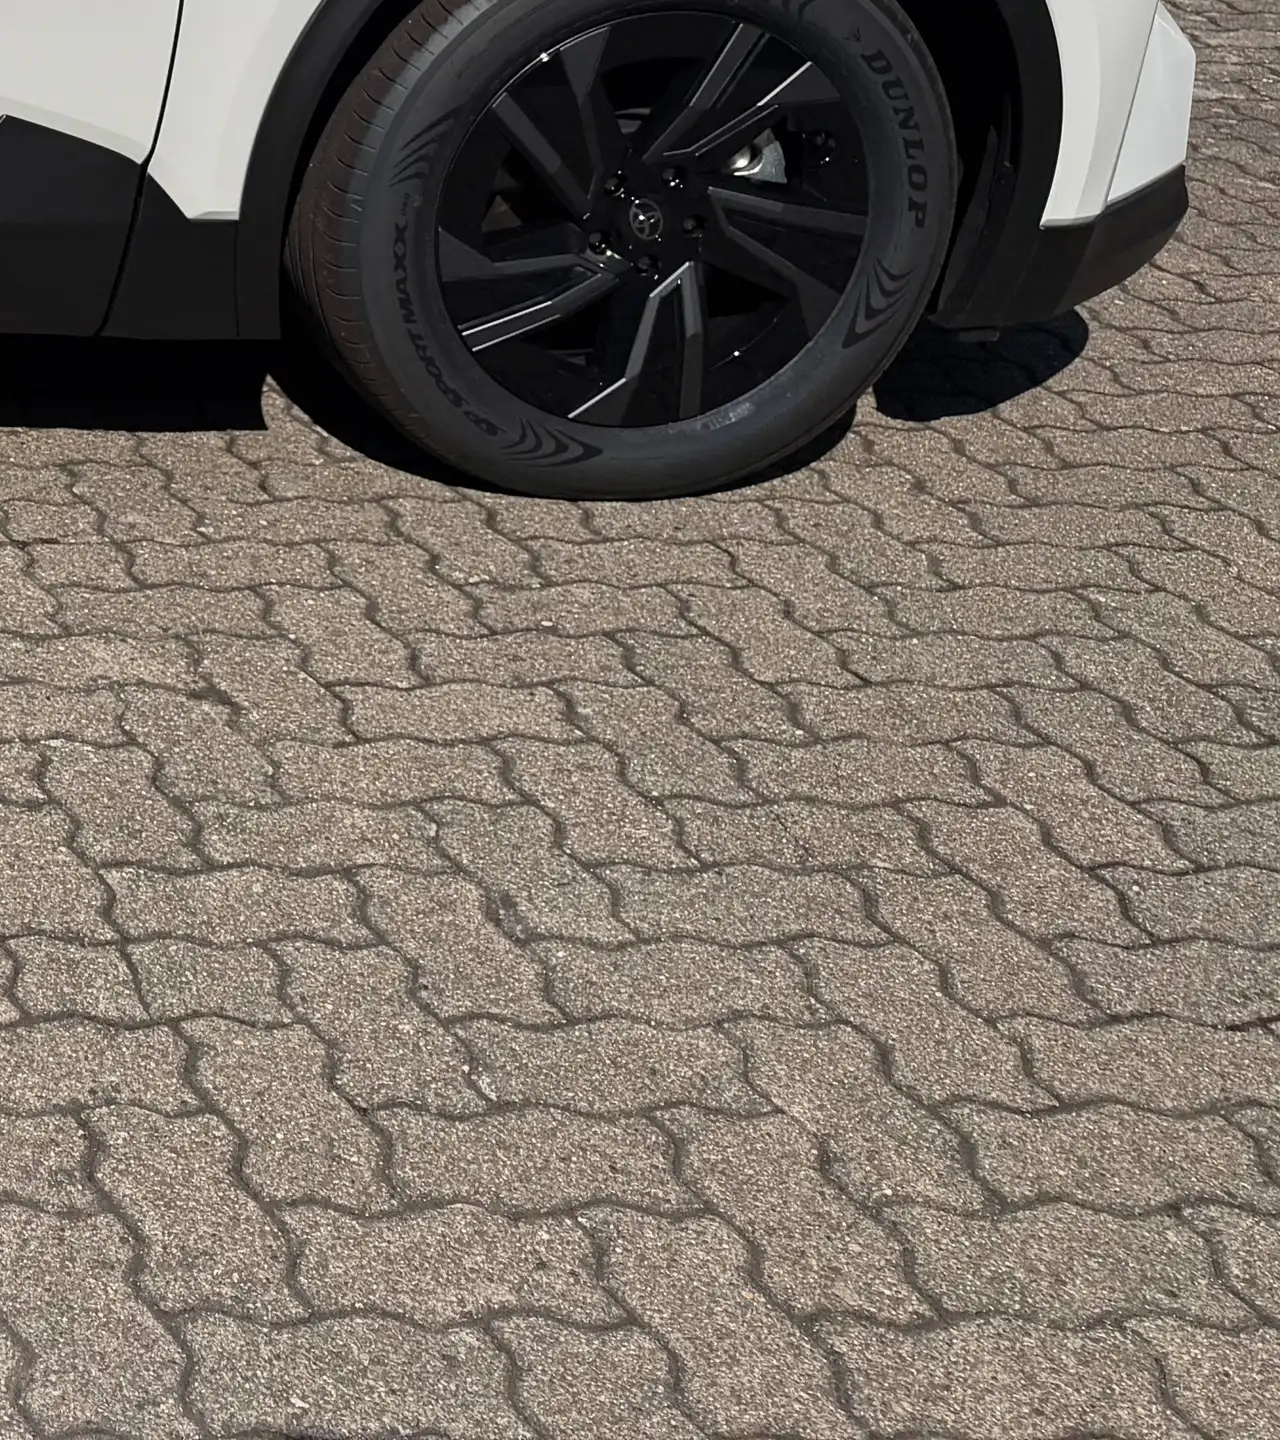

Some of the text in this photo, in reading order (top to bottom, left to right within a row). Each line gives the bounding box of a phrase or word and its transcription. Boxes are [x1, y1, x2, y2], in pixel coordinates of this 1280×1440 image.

[860, 48, 928, 229] DUNLOP
[393, 220, 417, 324] MAXX
[408, 328, 471, 408] SPORT
